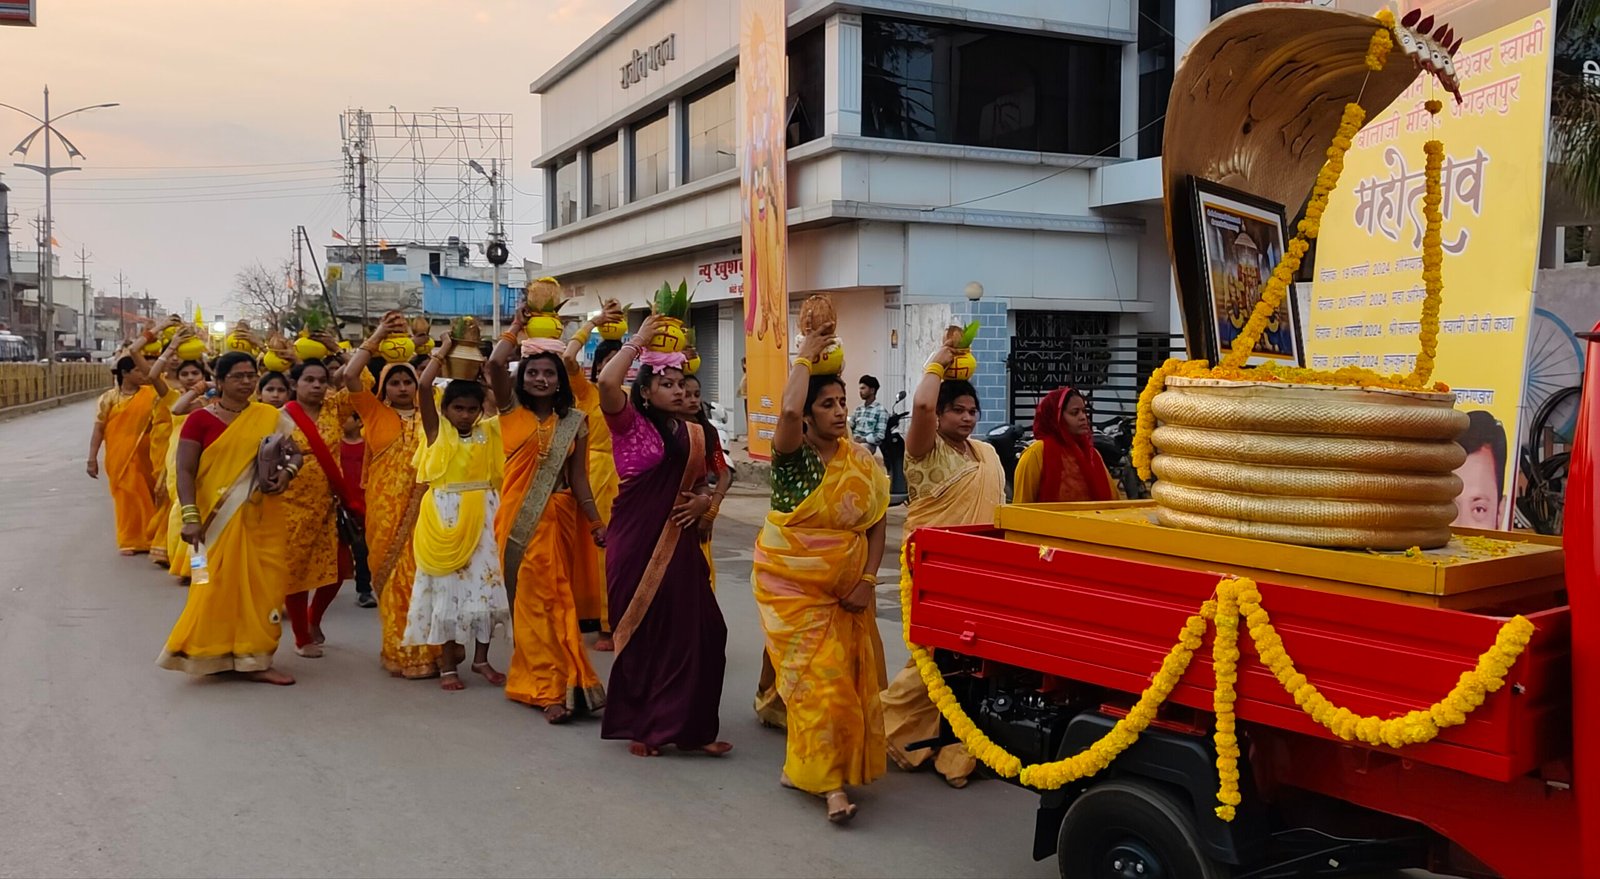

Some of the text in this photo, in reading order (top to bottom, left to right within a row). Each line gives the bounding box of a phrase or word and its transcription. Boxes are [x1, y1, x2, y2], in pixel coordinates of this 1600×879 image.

[1500, 20, 1546, 65] स्वामी
[1451, 76, 1521, 115] जगदलपुर
[1443, 314, 1465, 333] स्वामी
[1467, 313, 1478, 332] जी
[1480, 313, 1492, 331] की
[1494, 317, 1515, 331] कथा
